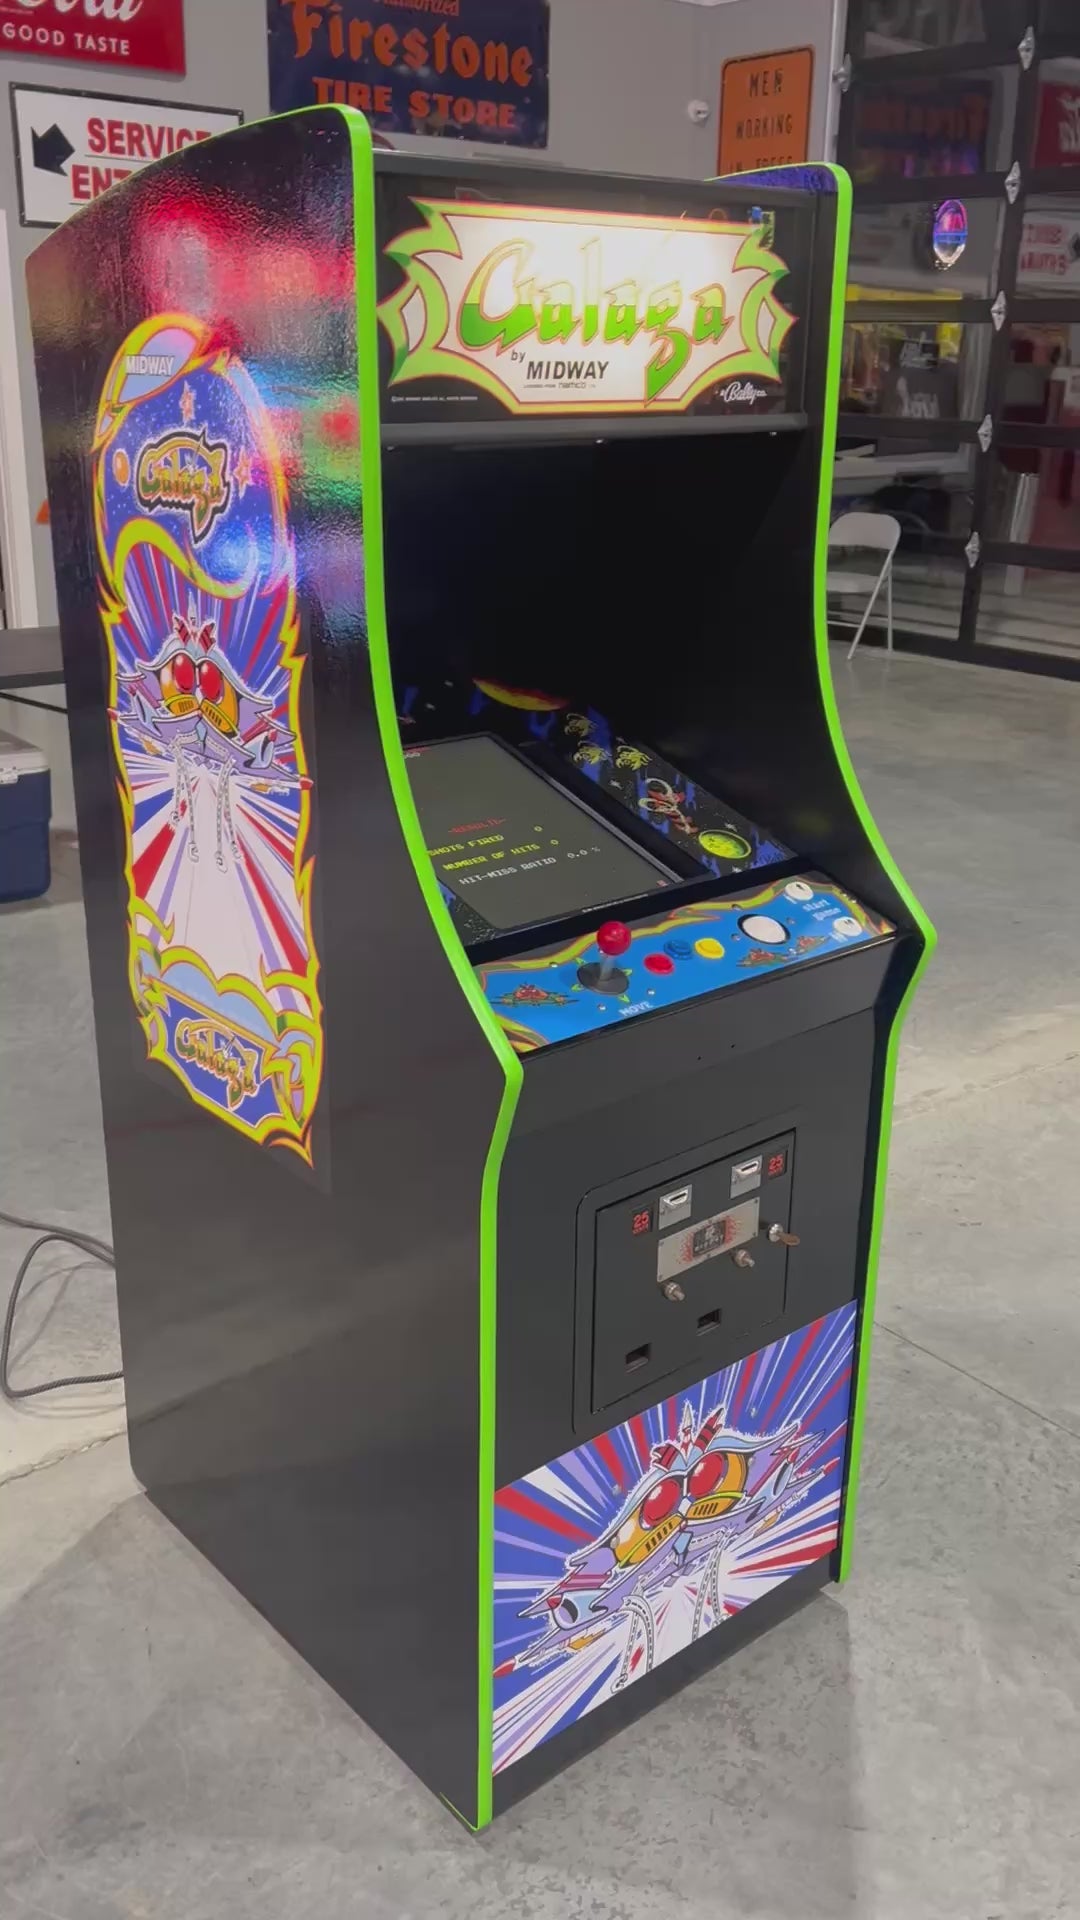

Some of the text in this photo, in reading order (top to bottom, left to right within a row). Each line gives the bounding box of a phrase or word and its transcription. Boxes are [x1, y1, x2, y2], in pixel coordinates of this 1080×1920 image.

[2, 22, 130, 56] GOOD TASTE
[279, 0, 533, 87] Firestone
[749, 67, 782, 97] MEN
[312, 76, 516, 128] TIRE STORE
[736, 113, 793, 139] WORKING
[456, 236, 734, 408] Galaga
[126, 355, 175, 376] MIDWAY
[511, 349, 525, 363] by
[526, 361, 609, 380] MIDWAY
[467, 834, 505, 847] FIRED
[442, 855, 488, 871] NUMBER
[510, 844, 541, 855] HITS
[459, 866, 518, 885] HIT-MISS
[520, 857, 557, 870] RATIO
[618, 1001, 653, 1018] MOVE
[768, 1153, 784, 1171] 25
[633, 1211, 649, 1229] 25
